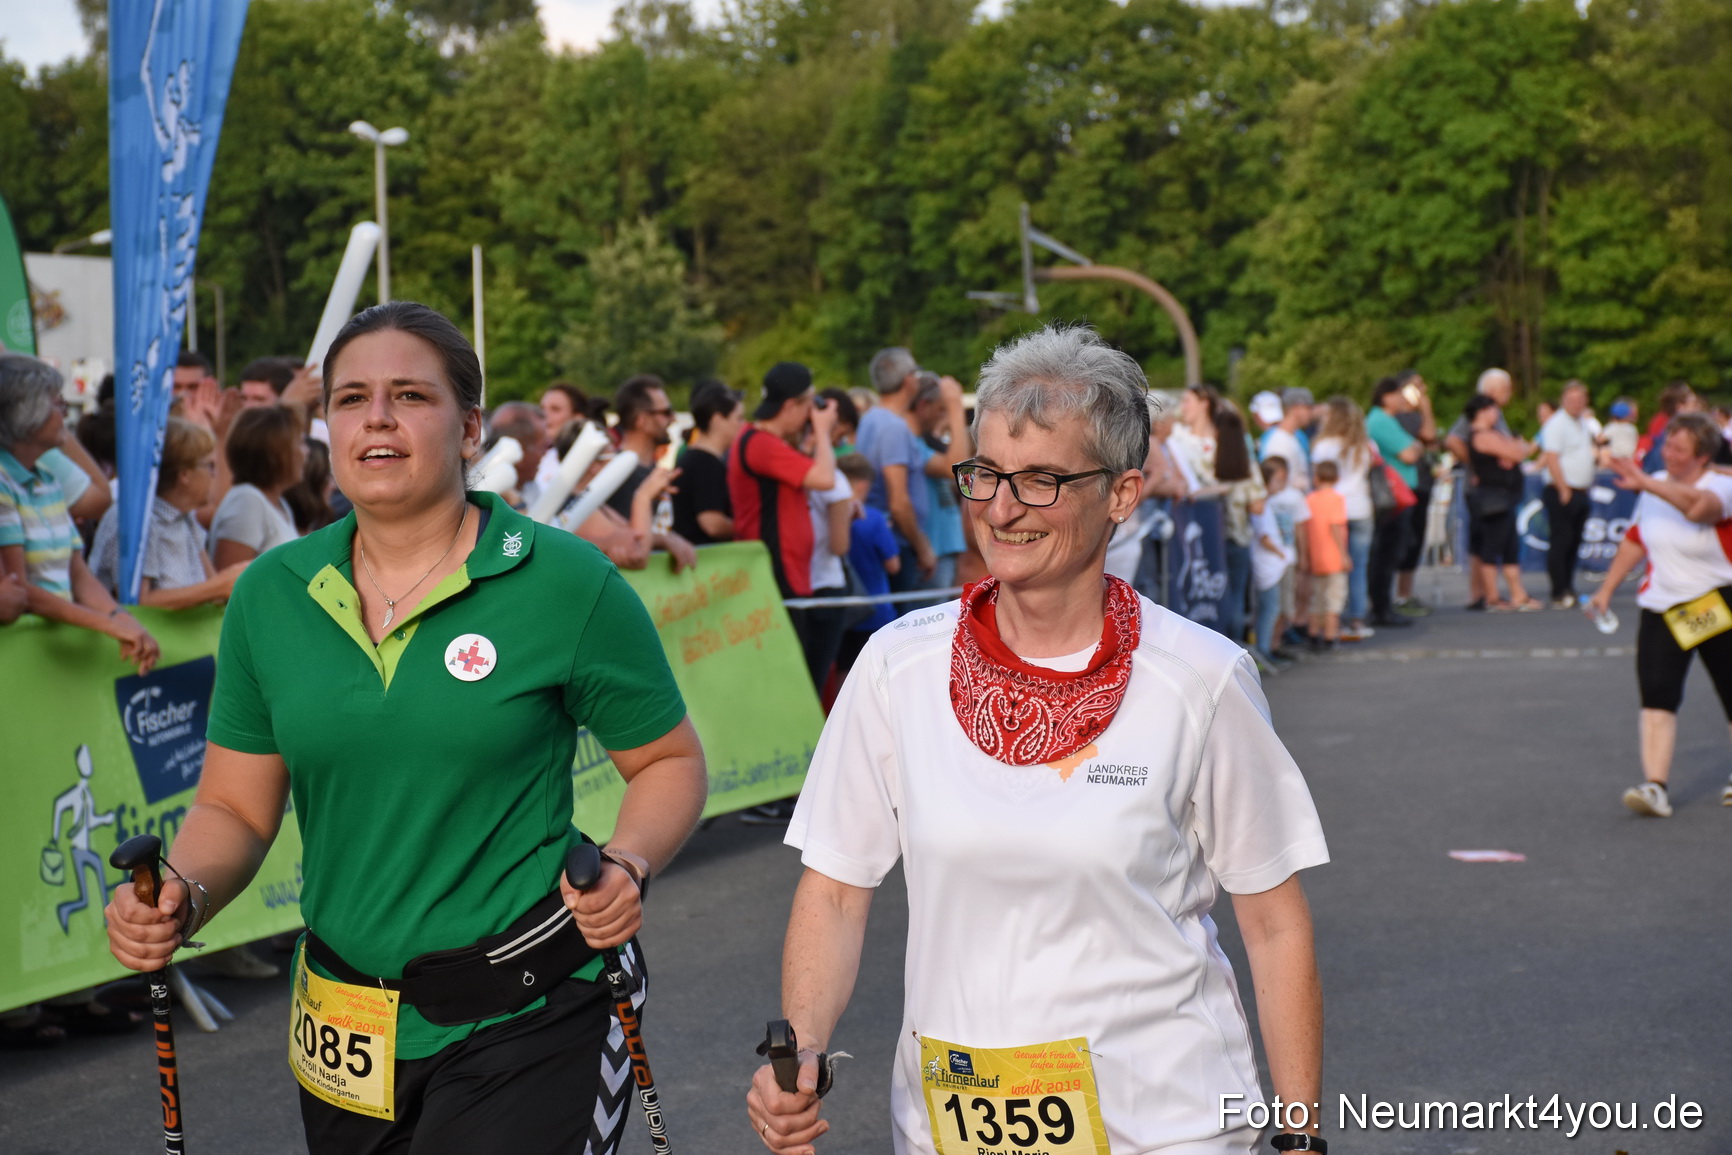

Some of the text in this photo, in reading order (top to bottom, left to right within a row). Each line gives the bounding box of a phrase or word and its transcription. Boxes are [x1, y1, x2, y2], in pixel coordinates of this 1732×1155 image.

[912, 612, 945, 627] JAKO
[137, 700, 197, 733] Fischer
[1088, 763, 1149, 776] LANDKREIS
[1086, 774, 1148, 787] NEUMARKT
[327, 1014, 385, 1036] walk 2019
[293, 998, 373, 1078] 2085
[1013, 1050, 1077, 1060] Gesunde Firmen
[301, 1054, 347, 1087] Pröll Nadja
[1030, 1060, 1056, 1070] laufen
[941, 1068, 1000, 1088] firmenlauf
[942, 1082, 968, 1091] neumarkt
[1011, 1078, 1081, 1096] walk 2019
[316, 1077, 361, 1101] Kindergarten
[944, 1093, 1075, 1148] 1359
